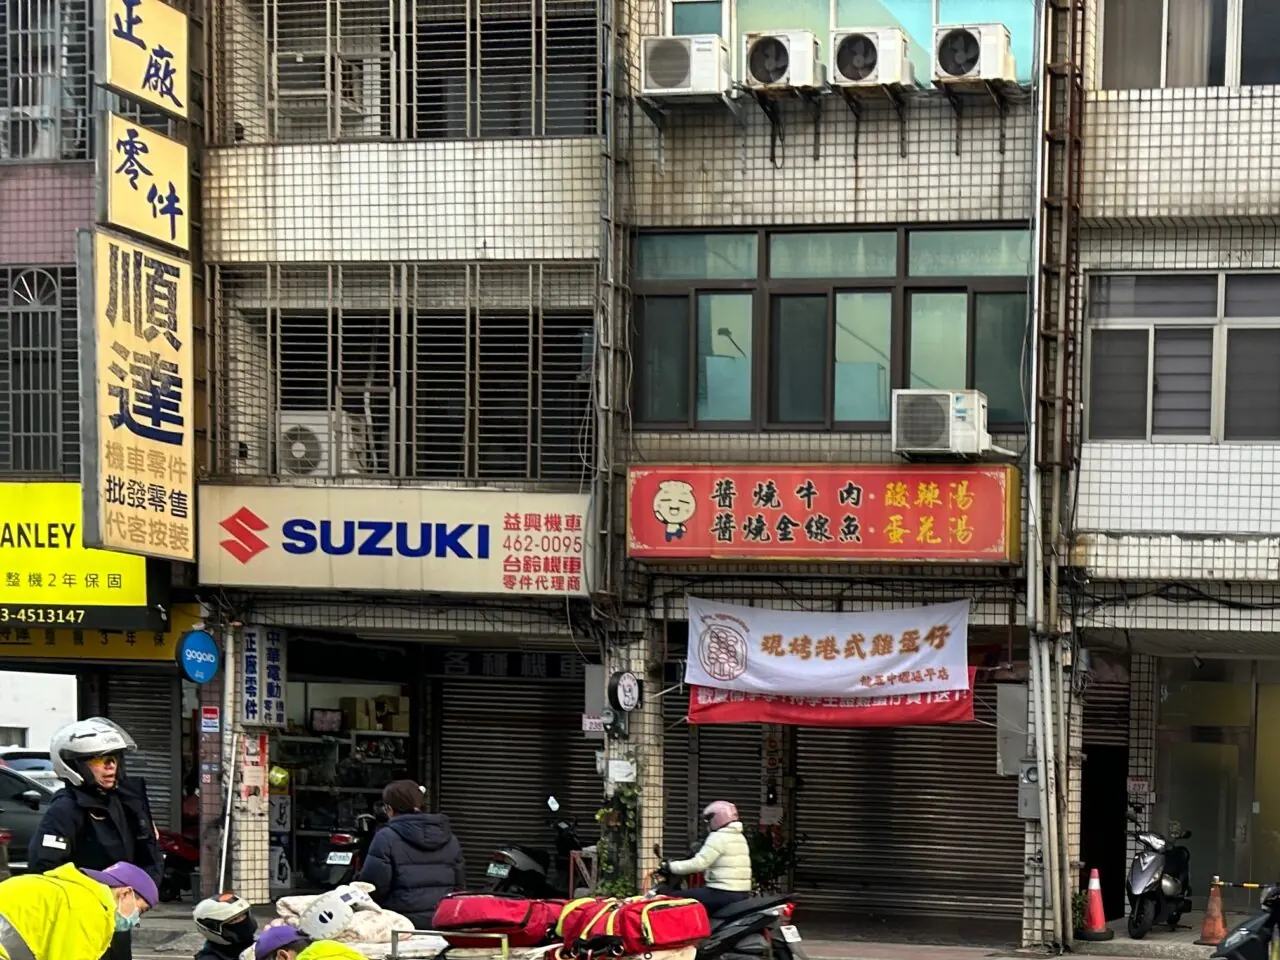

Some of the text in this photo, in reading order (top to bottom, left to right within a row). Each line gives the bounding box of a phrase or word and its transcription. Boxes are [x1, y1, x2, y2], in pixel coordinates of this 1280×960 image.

[111, 0, 184, 109] 正廠
[115, 128, 184, 241] 零件
[105, 243, 184, 446] 順達
[105, 440, 188, 483] 機車零件
[105, 475, 188, 519] 批發零售
[105, 510, 190, 552] 代客按裝
[281, 517, 490, 560] SUZUKI
[503, 512, 582, 532] 益興機車
[883, 514, 975, 544] 蛋花湯
[503, 535, 582, 553] 462-0095
[6, 572, 122, 589] 整機2年保固
[503, 555, 581, 574] 台鈴機車
[503, 575, 580, 591] 零件代理商
[1, 608, 85, 623] 3-4513147
[185, 648, 216, 664] gogoro
[245, 632, 257, 720] 正廠零件
